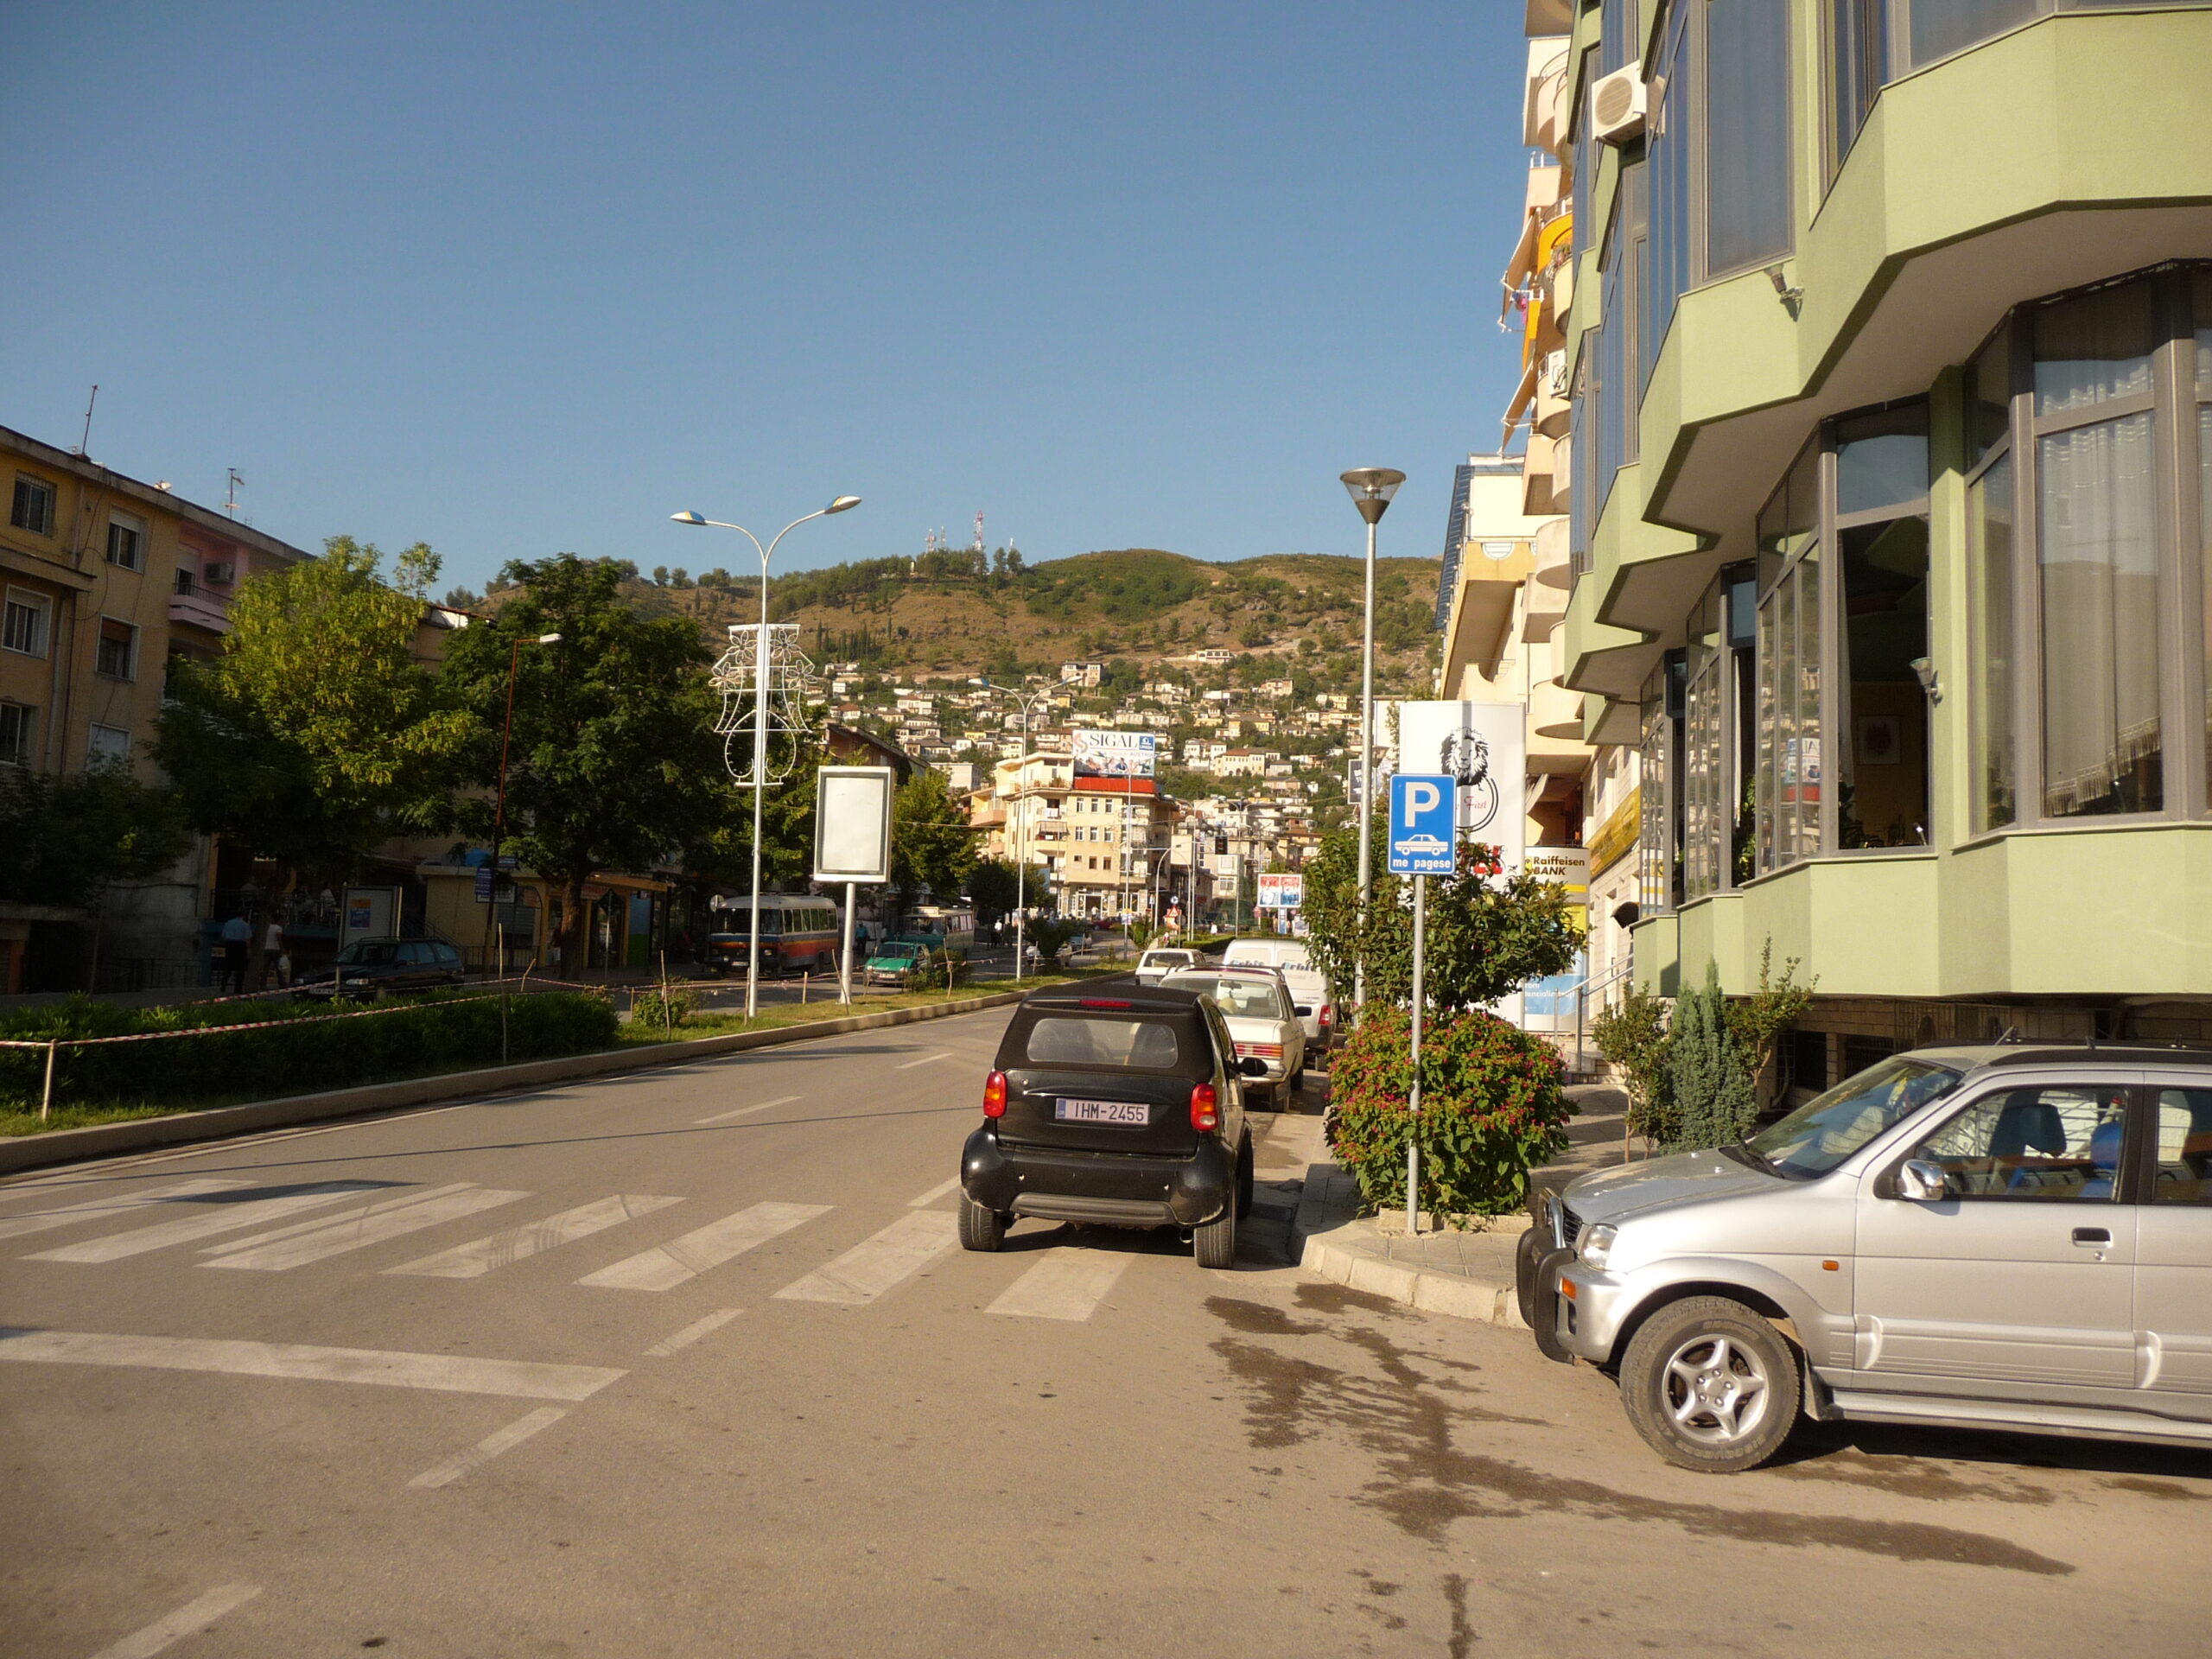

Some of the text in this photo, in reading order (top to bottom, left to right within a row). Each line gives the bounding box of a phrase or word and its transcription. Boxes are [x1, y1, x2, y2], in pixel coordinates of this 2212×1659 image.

[1090, 734, 1137, 747] SIGAL
[1405, 782, 1440, 827] P
[1393, 859, 1451, 869] me pagese
[1533, 855, 1585, 867] Raiffeisen
[1533, 866, 1566, 875] BANK
[1074, 1102, 1145, 1122] IHM-2455
